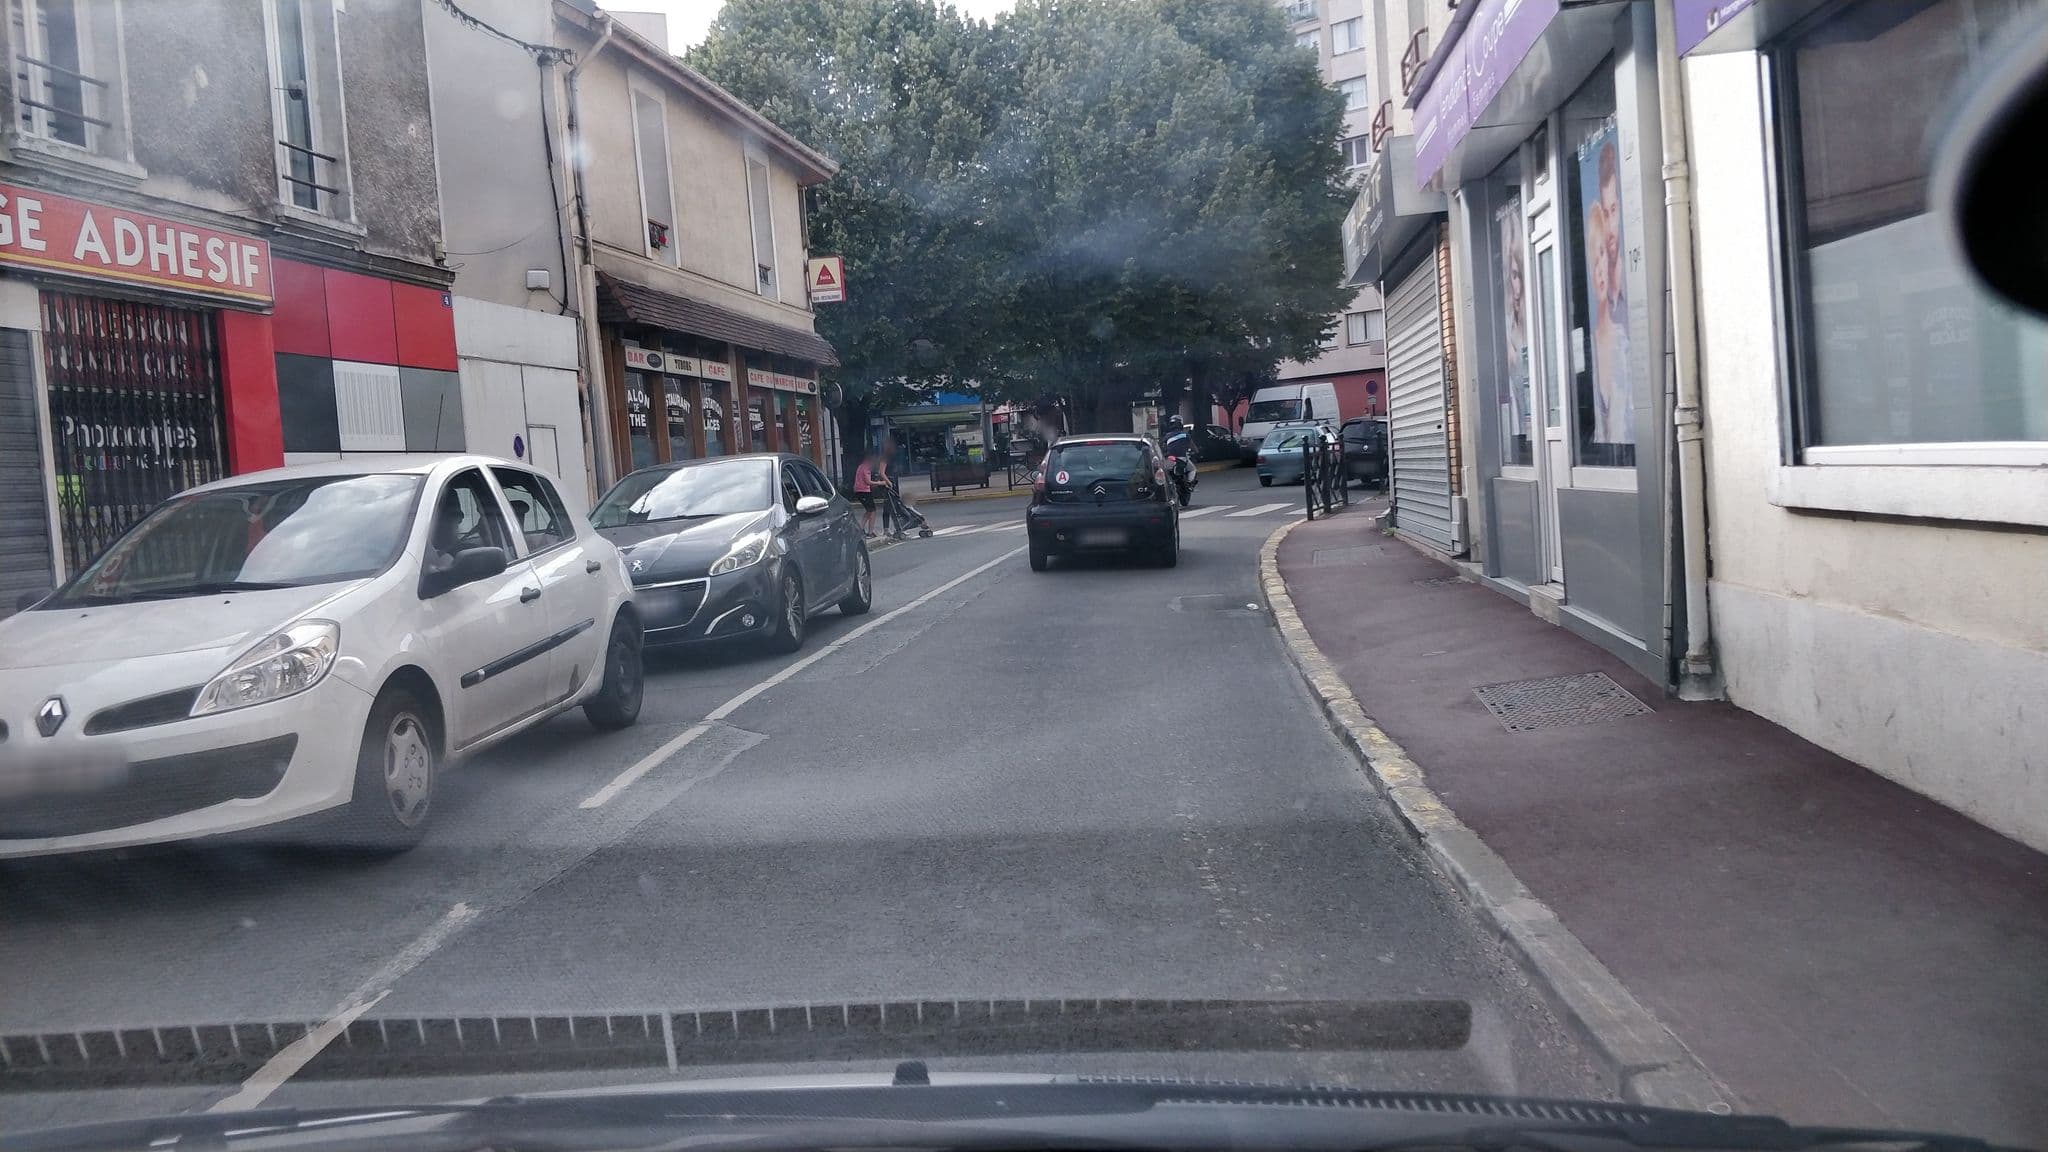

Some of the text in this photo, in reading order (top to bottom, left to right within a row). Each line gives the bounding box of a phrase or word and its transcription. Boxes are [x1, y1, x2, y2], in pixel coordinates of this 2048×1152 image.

[73, 209, 260, 288] ADHESIF
[628, 352, 645, 364] BAR
[708, 364, 725, 377] CAFE
[627, 388, 650, 409] ALON
[665, 393, 691, 414] STAURANT
[629, 413, 647, 427] THE
[704, 419, 721, 431] LACES
